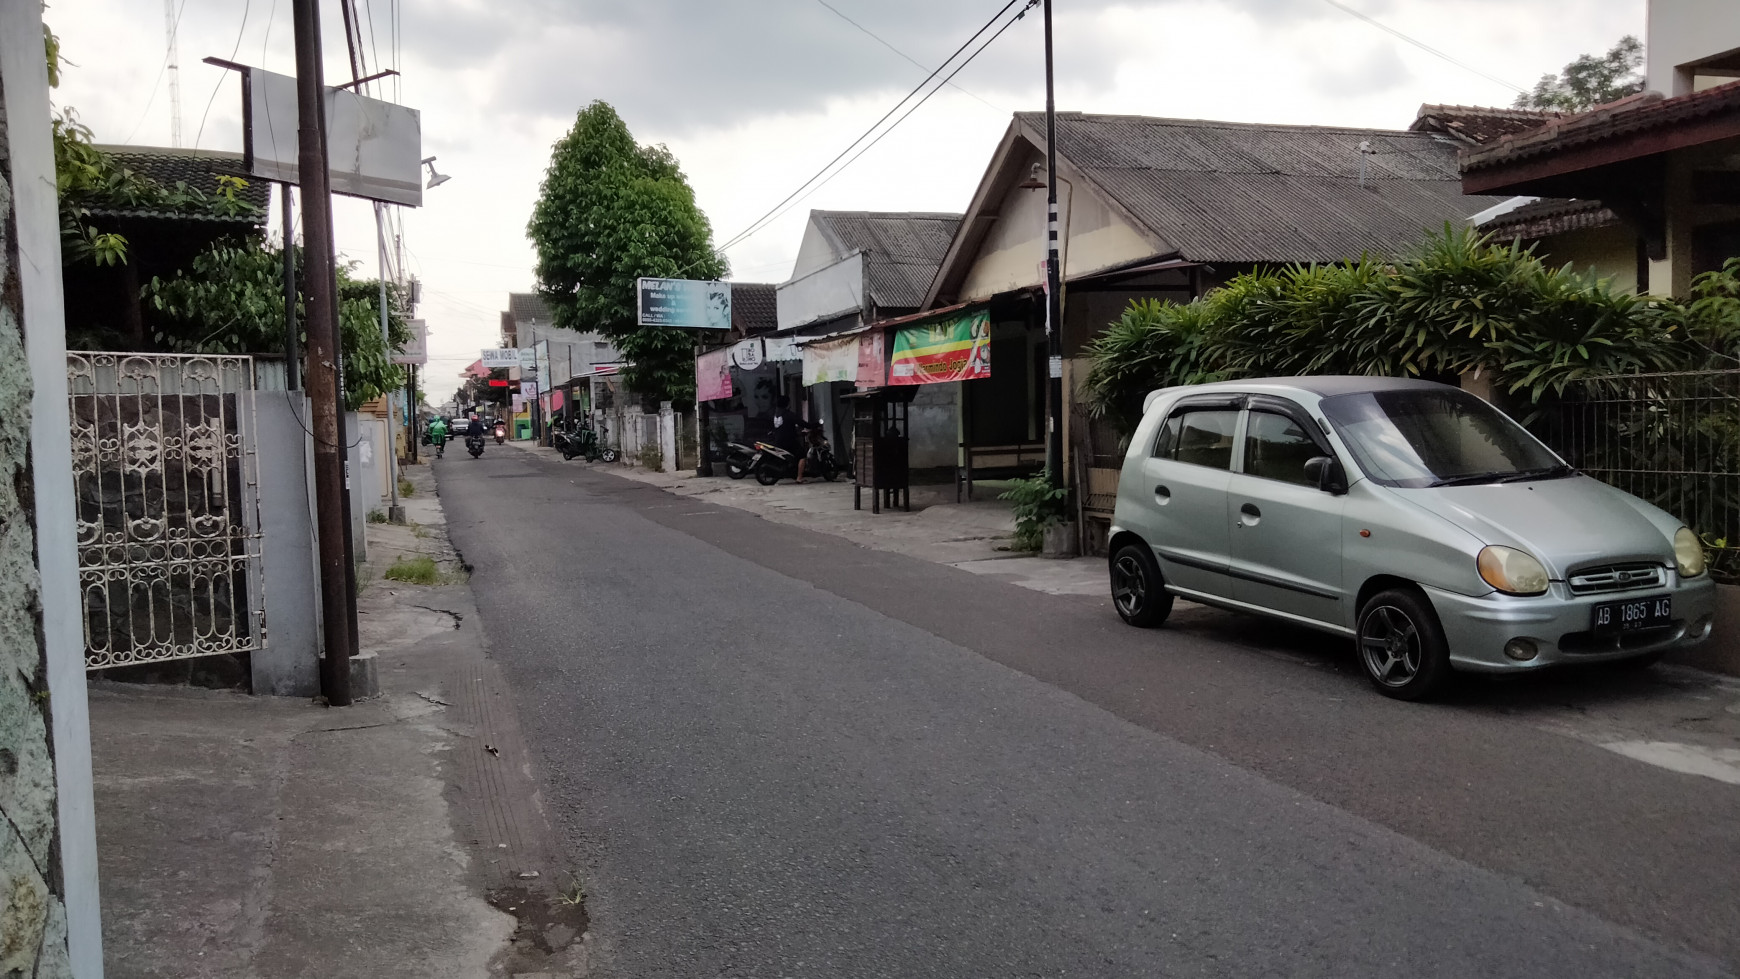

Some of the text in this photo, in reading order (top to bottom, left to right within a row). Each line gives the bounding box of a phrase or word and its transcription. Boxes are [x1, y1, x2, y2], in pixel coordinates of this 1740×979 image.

[642, 281, 681, 291] MELAN'S
[650, 306, 675, 314] wedding
[483, 350, 498, 360] SEWA
[500, 350, 517, 360] MOBIL
[949, 357, 968, 373] Jogja
[1598, 600, 1669, 625] AB 1865 AG
